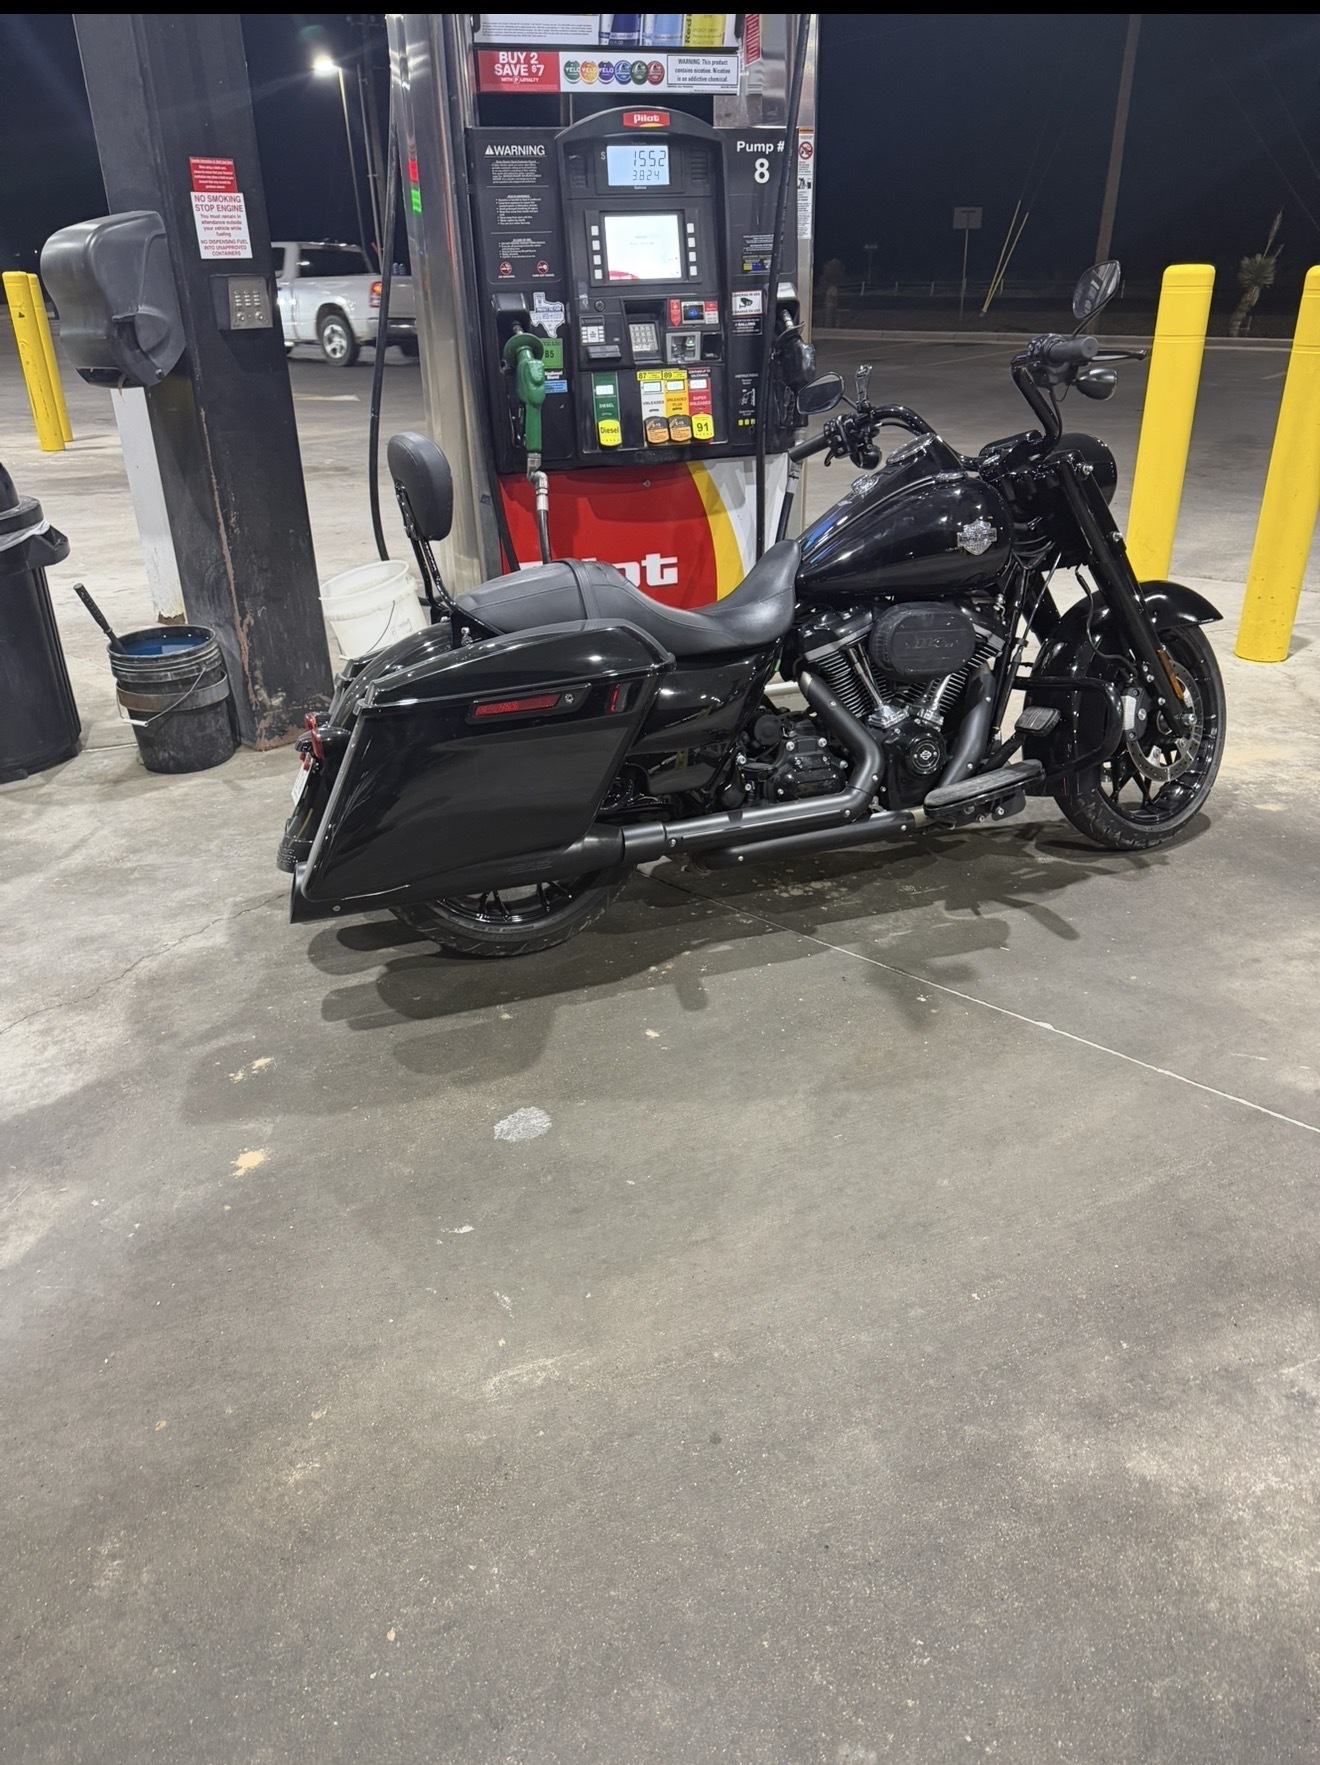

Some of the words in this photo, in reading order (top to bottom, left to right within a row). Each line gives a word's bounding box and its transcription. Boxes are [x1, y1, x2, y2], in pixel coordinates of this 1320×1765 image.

[499, 52, 527, 64] BUY
[530, 52, 538, 64] 2
[494, 64, 528, 76] SAVE
[531, 65, 544, 76] $7
[633, 114, 660, 124] Pilot
[493, 145, 546, 155] WARNING
[737, 141, 774, 155] Pump
[777, 141, 785, 152] #
[754, 158, 770, 183] 8
[207, 195, 241, 203] SMOKING
[195, 204, 214, 212] STOP
[696, 422, 709, 432] 91
